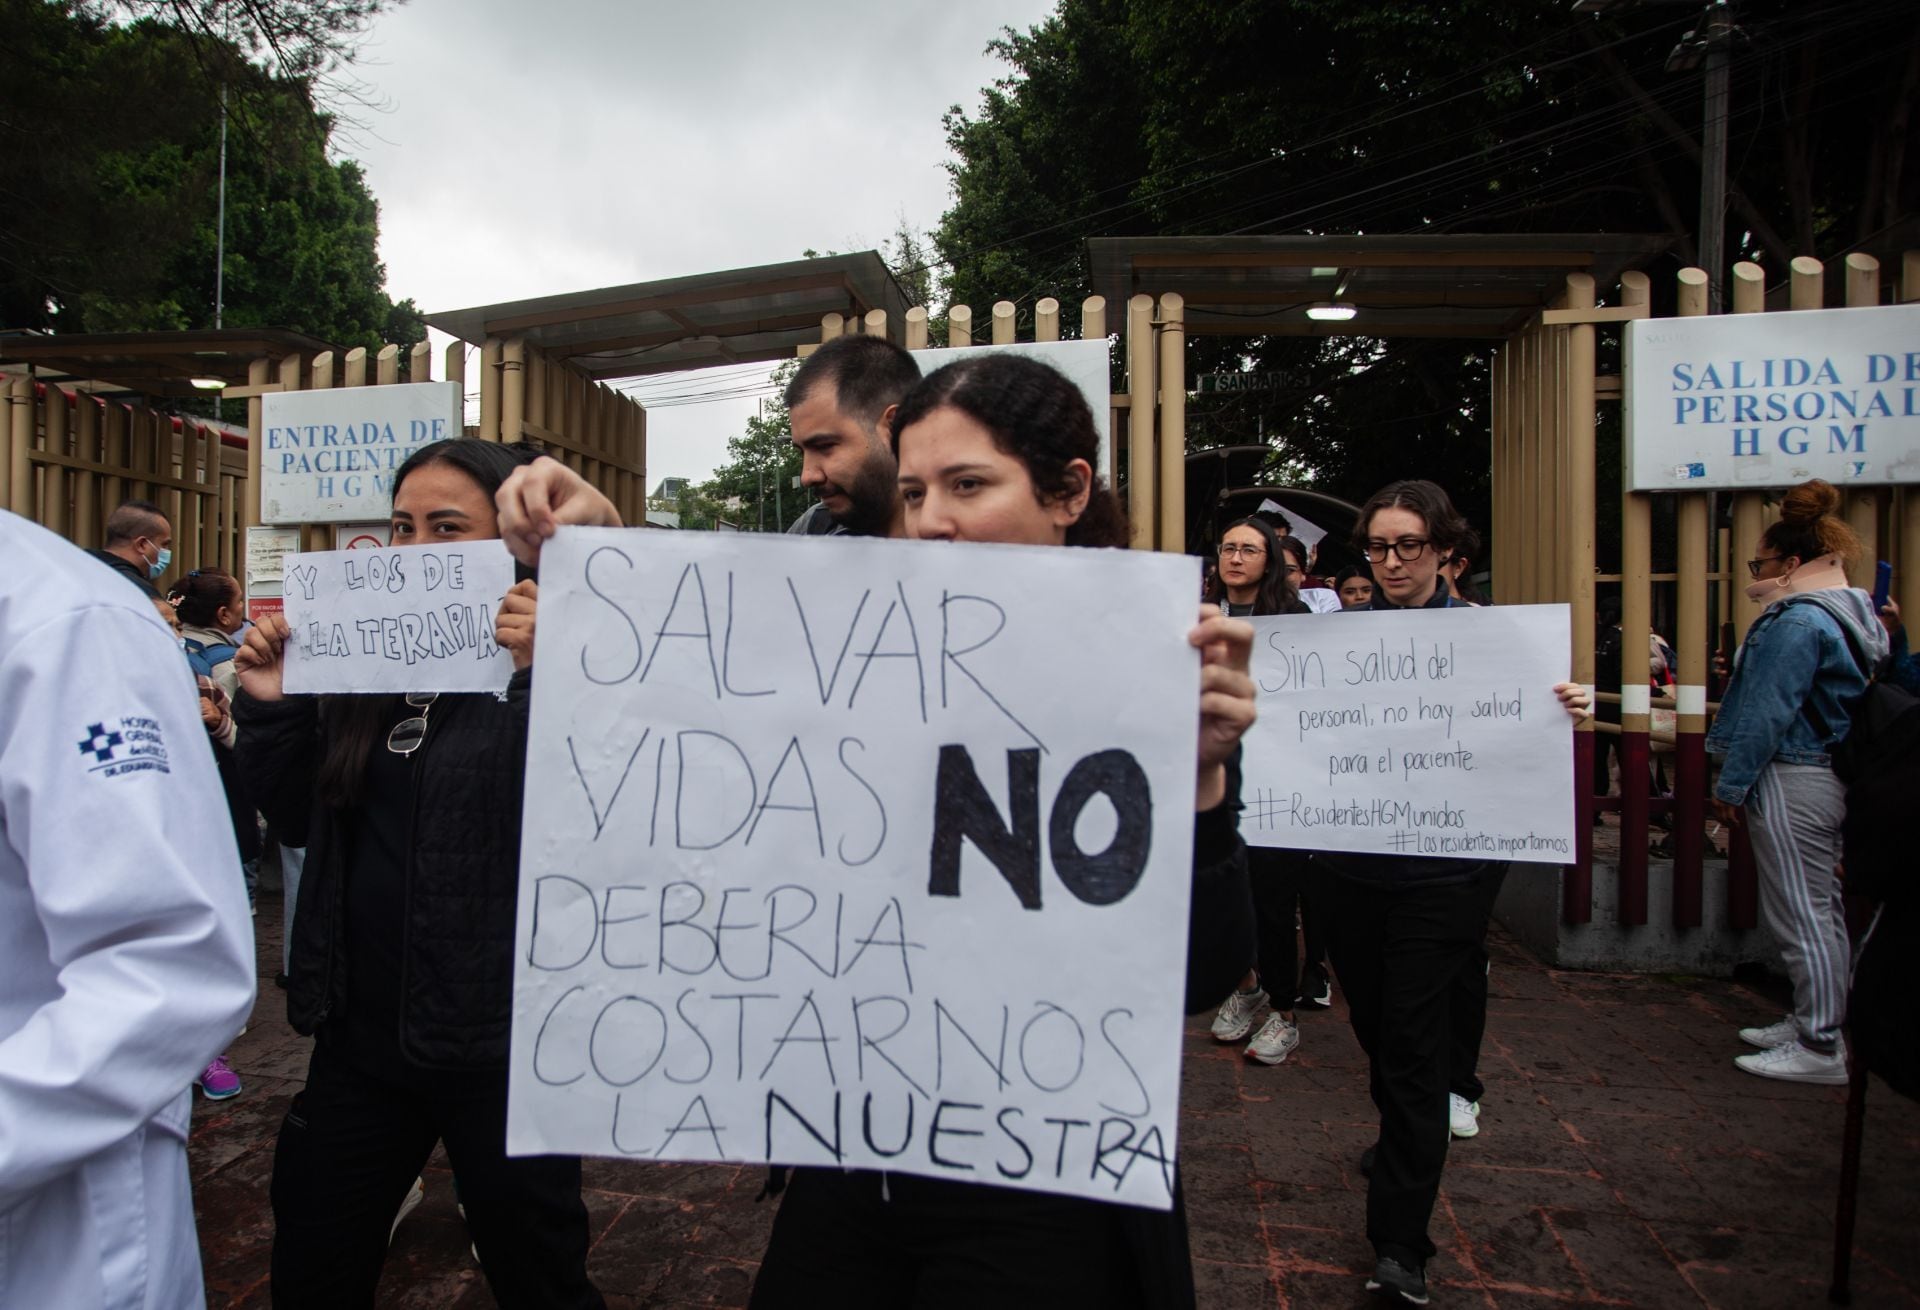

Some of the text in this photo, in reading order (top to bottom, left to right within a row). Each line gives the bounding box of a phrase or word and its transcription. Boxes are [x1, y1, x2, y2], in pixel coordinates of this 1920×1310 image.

[1672, 352, 1920, 391] SALIDA DE
[1674, 387, 1920, 424] PERSONAL
[268, 418, 446, 449] ENTRADA DE
[282, 447, 417, 474] PACIENTE
[345, 554, 405, 593] LOS
[422, 553, 464, 591] DE
[309, 622, 350, 657] LA
[580, 545, 1050, 753] SALVAR
[1259, 631, 1454, 692] Sin salud del
[1299, 688, 1521, 742] personal, no hay salud
[1329, 754, 1368, 786] para
[1378, 747, 1392, 773] el
[568, 728, 1153, 910] VIDAS NO
[527, 874, 926, 994] DEBERIA
[533, 986, 1150, 1118] COSTARNOS
[612, 1089, 1173, 1198] LA NUESTRA
